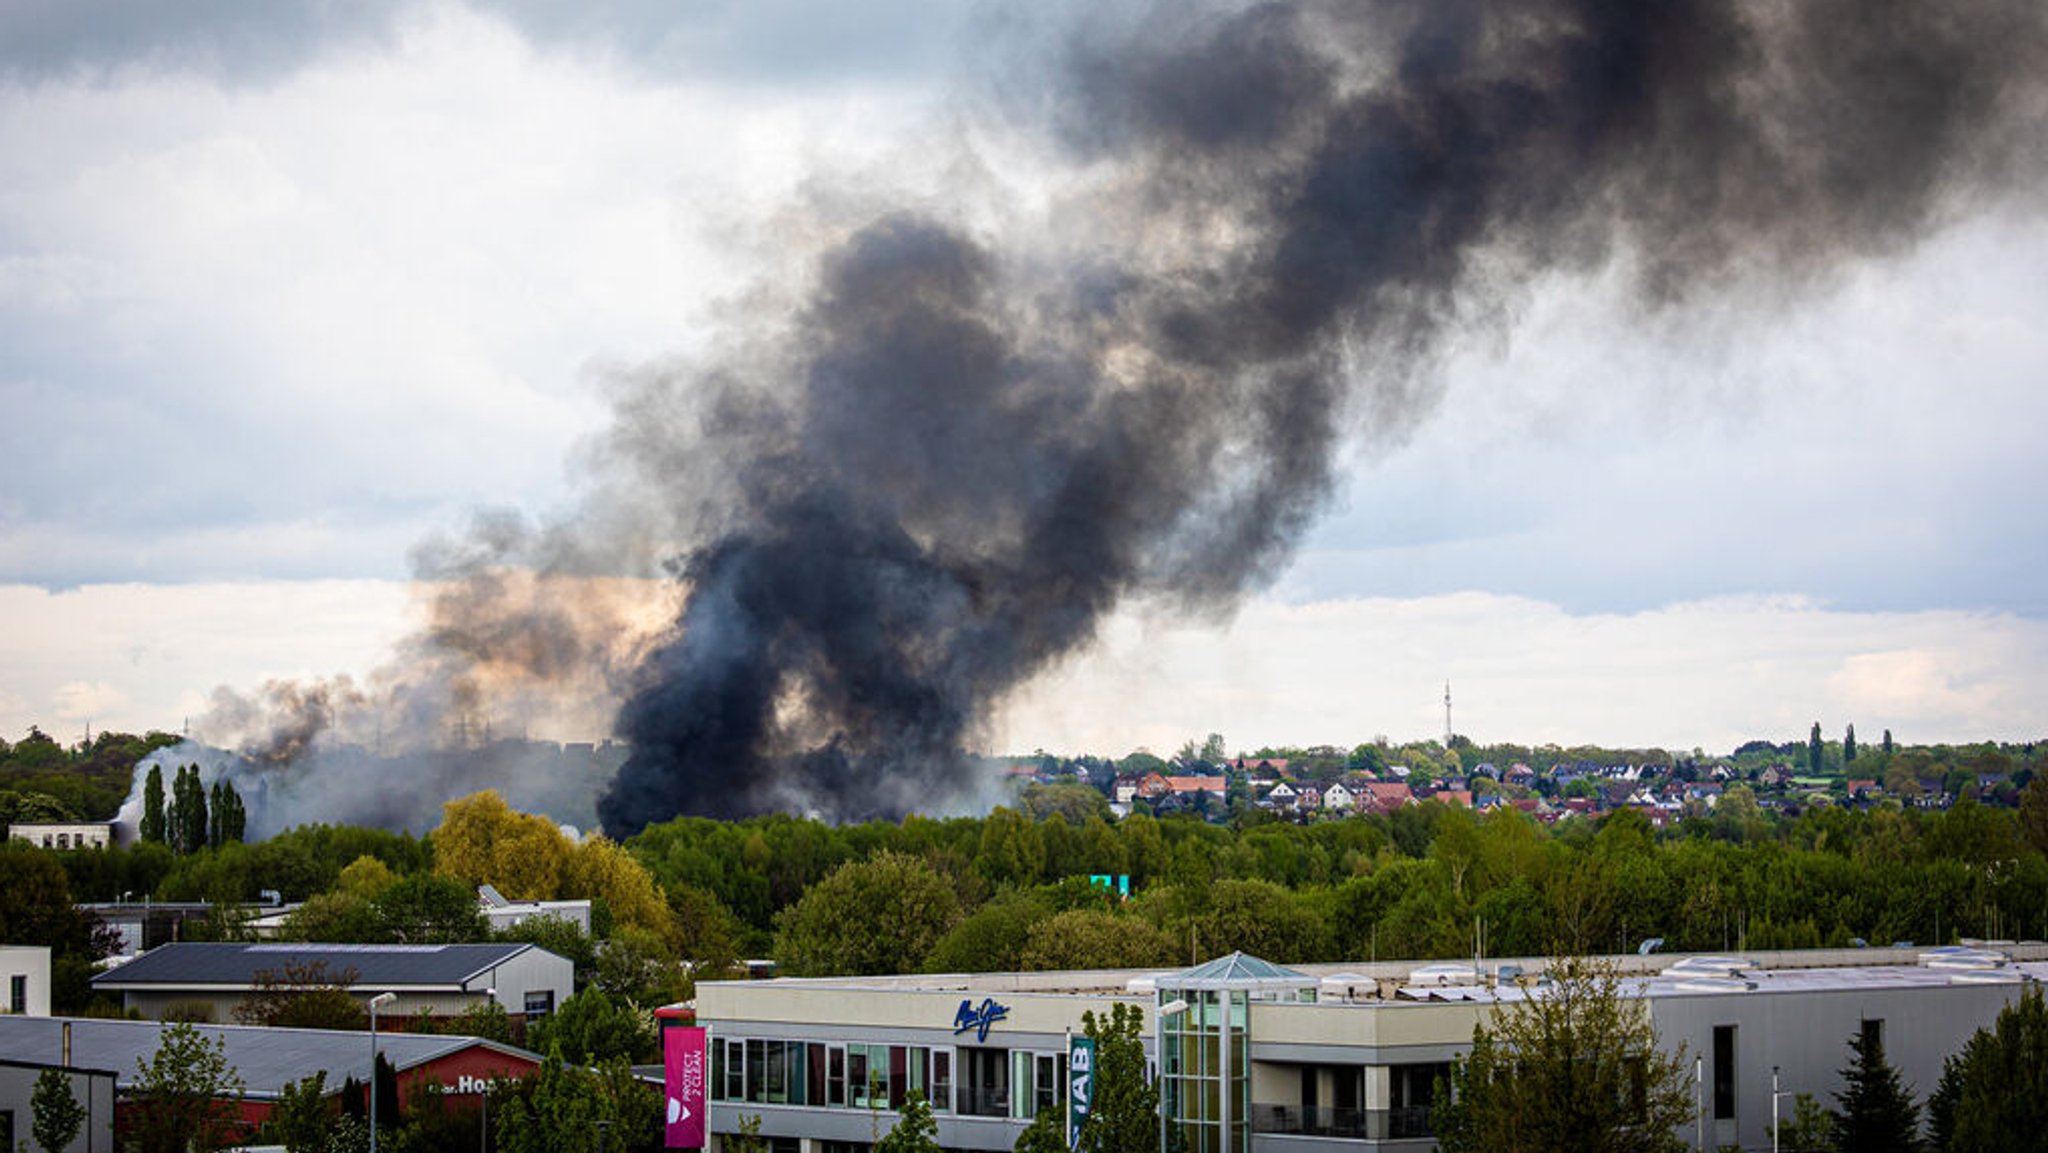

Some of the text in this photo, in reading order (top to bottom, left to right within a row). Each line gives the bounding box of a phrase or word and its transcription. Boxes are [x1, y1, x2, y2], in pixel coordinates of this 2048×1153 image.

[682, 1052, 691, 1102] PROTECT
[692, 1050, 702, 1096] 2 CLEAN
